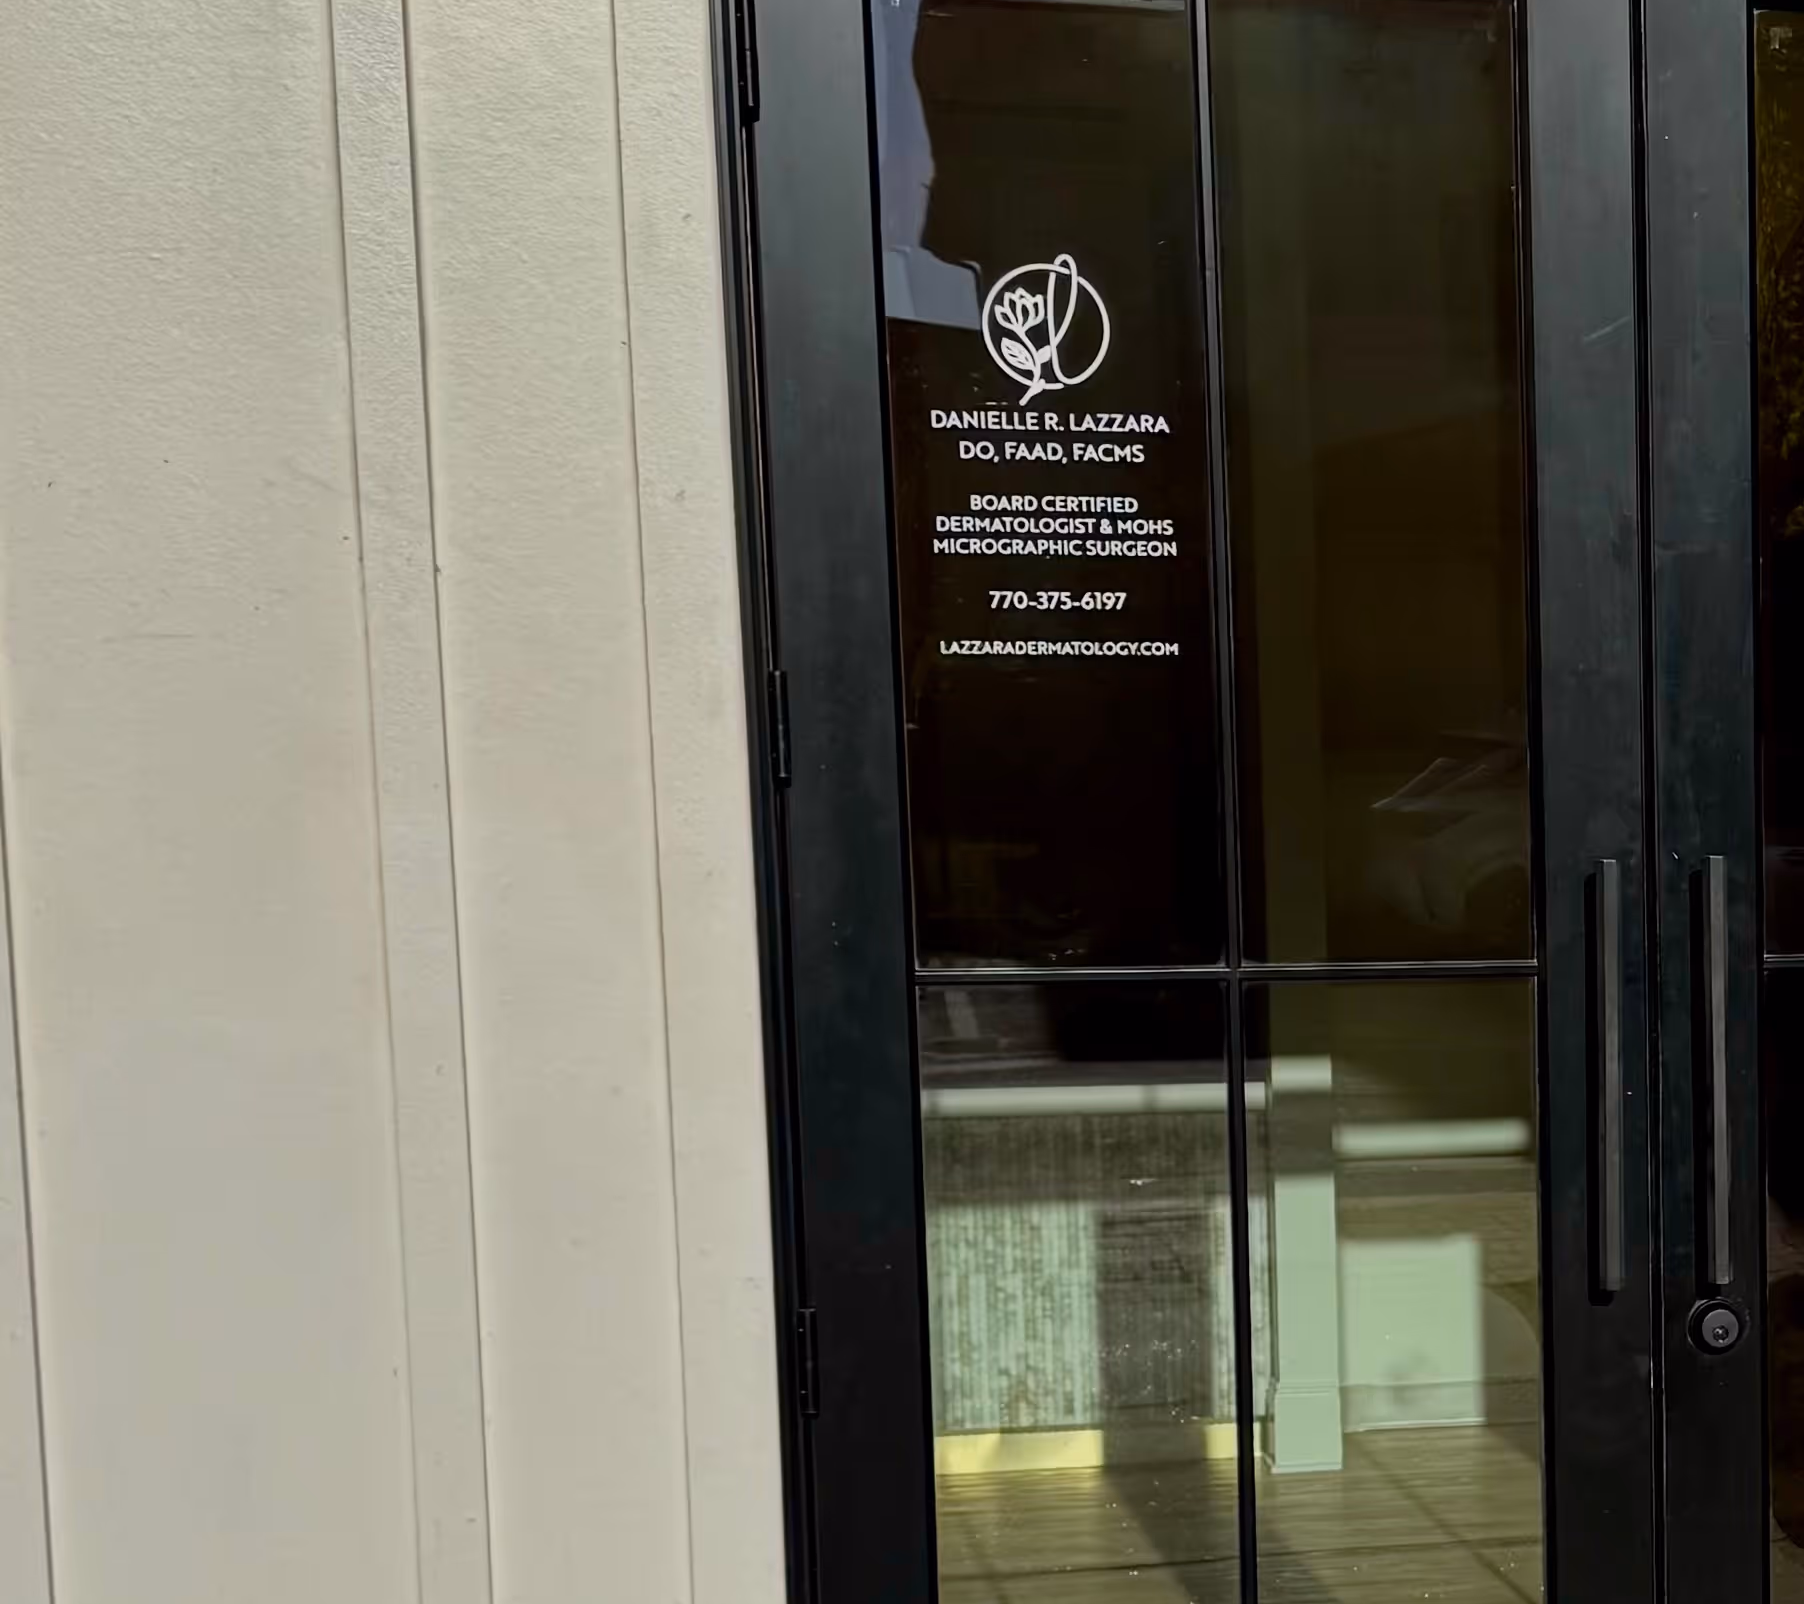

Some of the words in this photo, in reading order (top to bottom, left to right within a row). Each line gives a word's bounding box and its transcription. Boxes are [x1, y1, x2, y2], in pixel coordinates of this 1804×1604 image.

[931, 410, 1039, 431] DANIELLE
[1045, 413, 1064, 431] R.
[1070, 414, 1170, 433] LAZZARA
[960, 441, 999, 463] DO,
[1005, 442, 1067, 464] FAAD,
[1073, 443, 1145, 463] FACMS
[970, 495, 1038, 511] BOARD
[1042, 496, 1138, 513] CERTIFIED
[936, 516, 1096, 534] DERMATOLOGIST
[1100, 519, 1112, 534] &
[1118, 519, 1174, 535] MOHS
[933, 538, 1082, 555] MICROGRAPHIC
[1086, 540, 1178, 557] SURGEON
[989, 591, 1127, 610] 770-375-6197
[940, 640, 1179, 656] LAZZARADERMATOLOGY.COM
